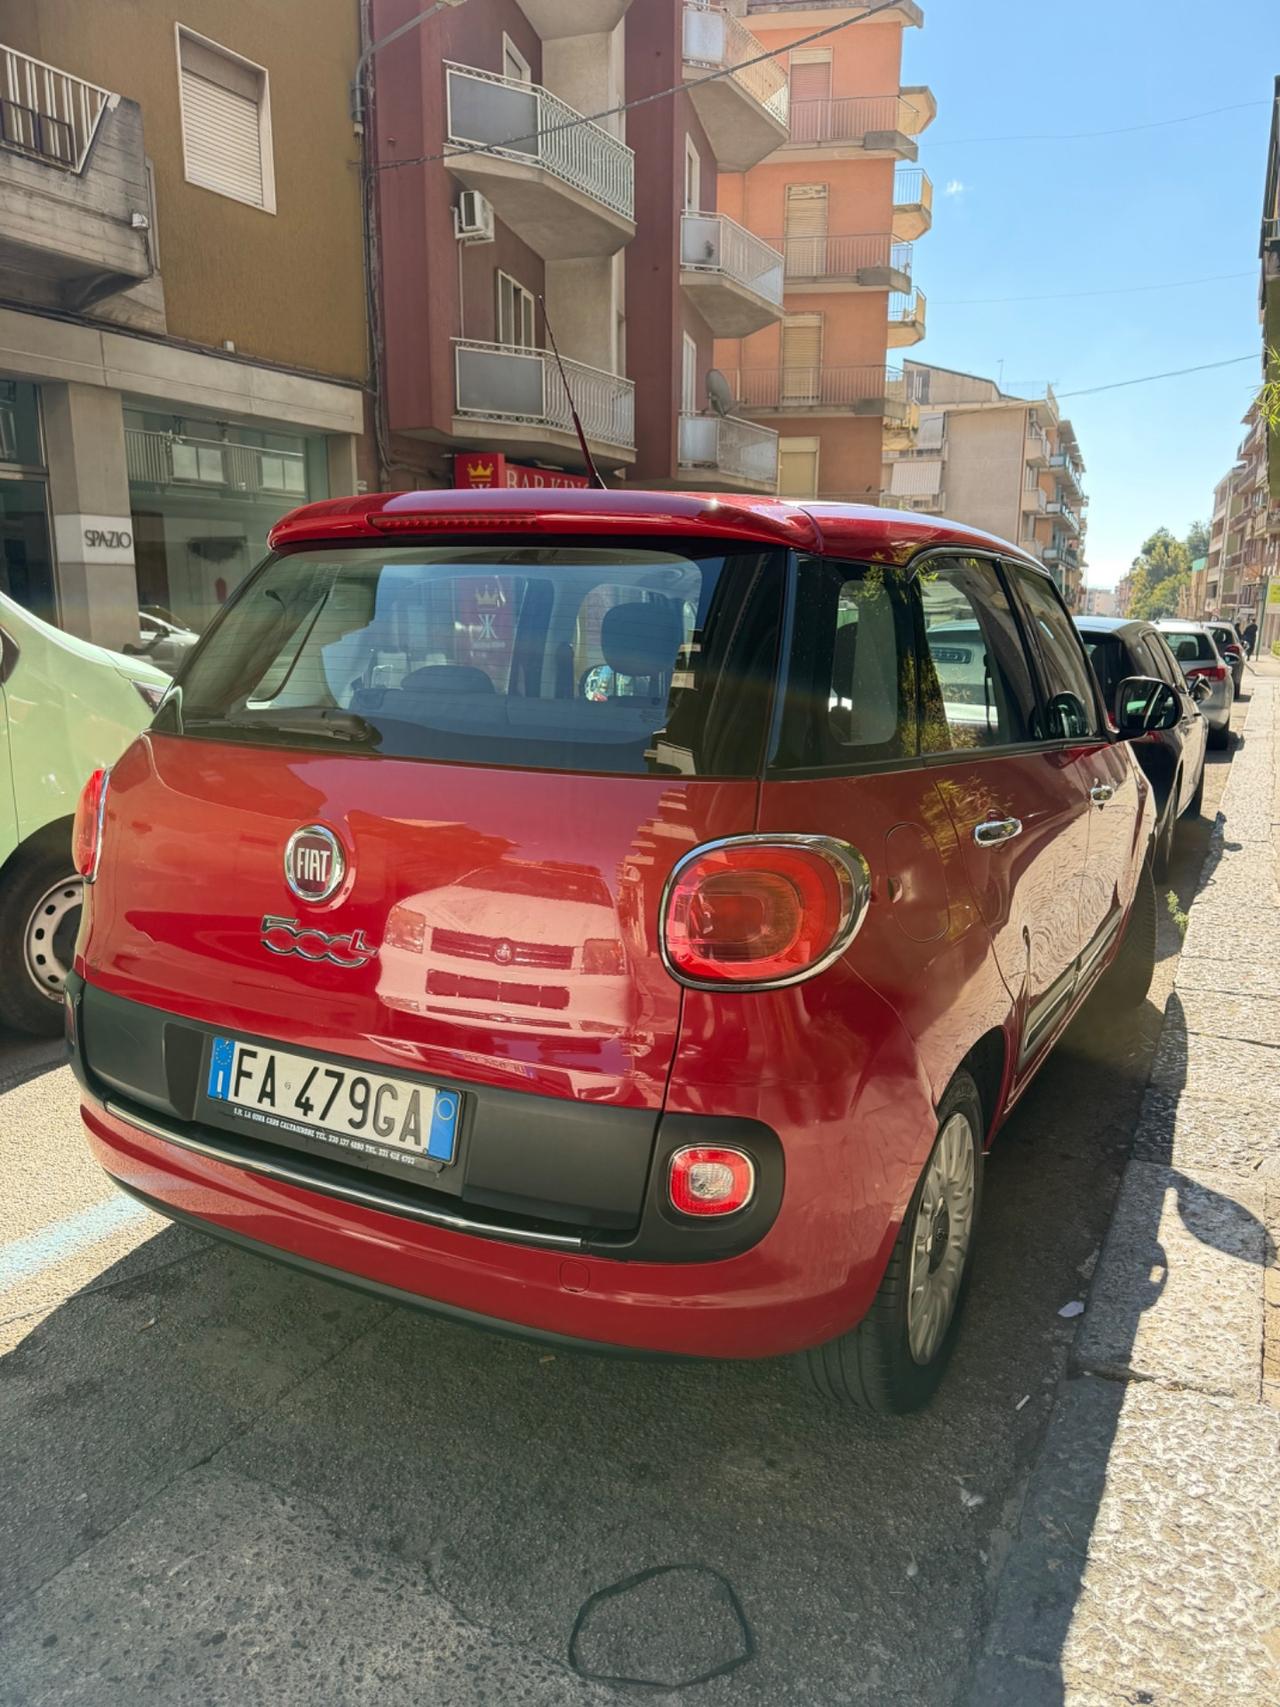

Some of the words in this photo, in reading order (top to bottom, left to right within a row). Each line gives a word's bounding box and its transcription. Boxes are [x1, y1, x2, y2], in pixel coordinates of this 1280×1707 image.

[84, 529, 132, 549] SPAZIO
[297, 847, 331, 882] FIAT
[261, 914, 379, 969] 500L
